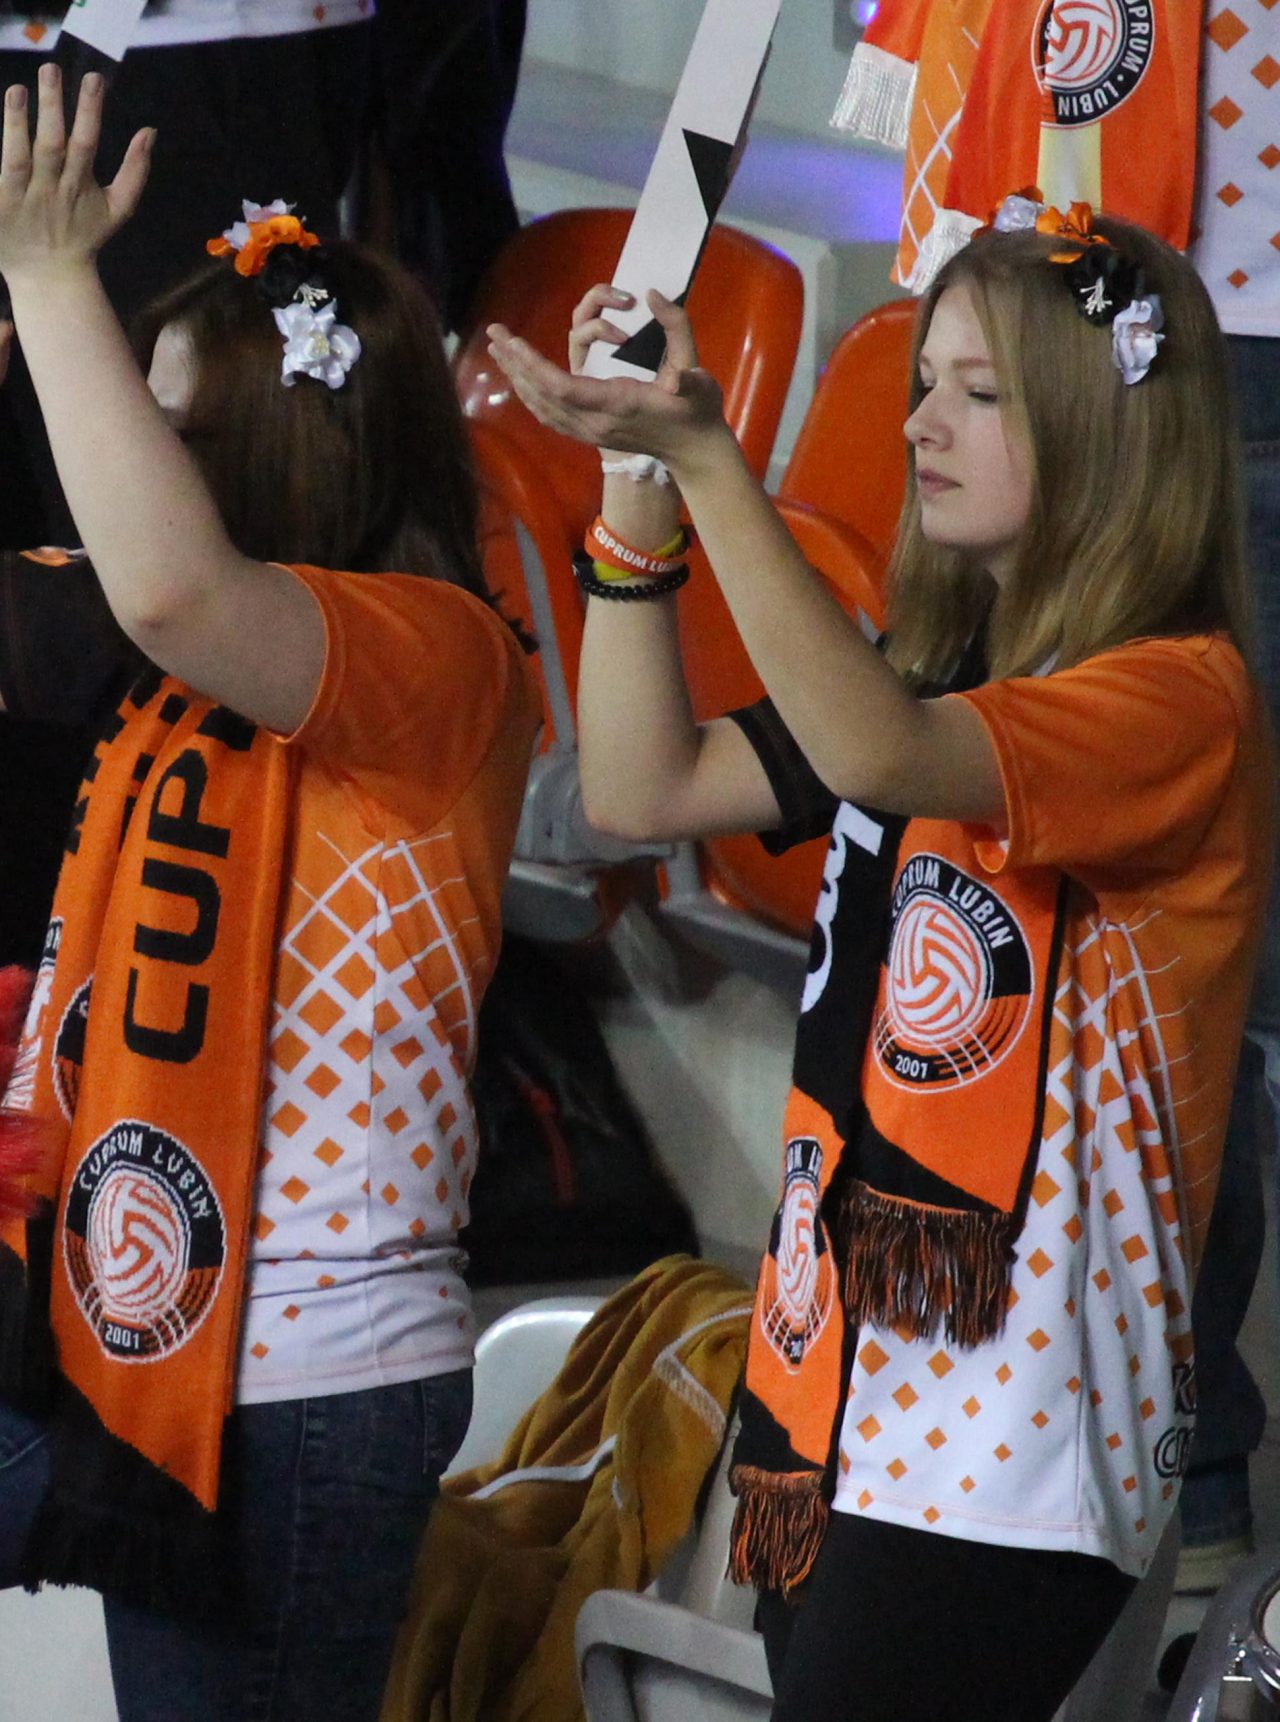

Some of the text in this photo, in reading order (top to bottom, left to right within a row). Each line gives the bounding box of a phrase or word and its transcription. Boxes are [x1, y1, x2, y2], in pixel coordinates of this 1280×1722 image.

[1058, 0, 1150, 117] PRUM LUBIN
[594, 526, 648, 570] CUPRUM
[948, 876, 1014, 949] LUBIN
[895, 1054, 928, 1079] 2001
[79, 1130, 213, 1219] CUPRUM LUBIN
[105, 1323, 139, 1349] 2001
